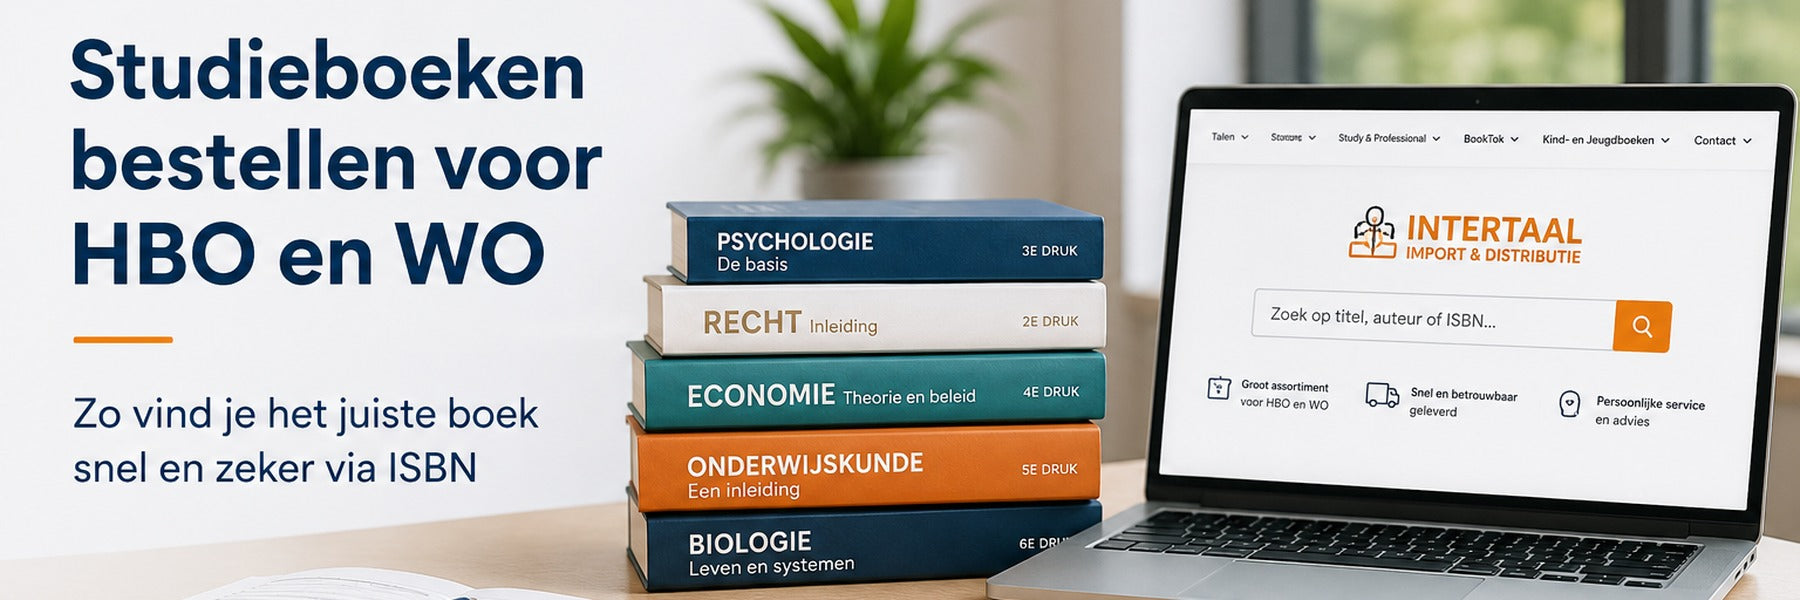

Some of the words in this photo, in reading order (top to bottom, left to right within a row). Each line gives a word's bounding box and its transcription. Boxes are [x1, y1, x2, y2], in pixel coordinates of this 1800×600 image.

[1212, 132, 1235, 141] Talen
[1339, 133, 1364, 144] Study
[1365, 134, 1371, 142] &
[1374, 134, 1426, 143] Professional
[1464, 134, 1504, 143] BookTok
[1543, 135, 1569, 144] Kind-
[1586, 135, 1654, 147] Jeugdboeken
[1694, 136, 1736, 145] Contact
[1408, 215, 1582, 244] INTERTAAL
[718, 232, 873, 250] PSYCHOLOGIE
[1023, 245, 1037, 256] 3E
[1042, 246, 1077, 256] DRUK
[1406, 246, 1466, 260] IMPORT
[1470, 248, 1480, 261] &
[1486, 248, 1581, 264] DISTRIBUTIE
[718, 257, 740, 271] De
[746, 257, 787, 271] basis
[705, 310, 802, 334] RECHT
[811, 319, 877, 336] Inleiding
[1023, 316, 1038, 327] 2E
[1043, 316, 1078, 326] DRUK
[1271, 307, 1307, 321] Zoek
[1312, 312, 1330, 325] op
[1335, 309, 1368, 325] titel,
[1373, 313, 1422, 325] auteur
[1427, 312, 1442, 326] of
[1447, 313, 1495, 328] ISBN...
[1024, 387, 1038, 397] 4E
[1044, 386, 1079, 397] DRUK
[1242, 379, 1267, 391] Groot
[1271, 382, 1328, 392] assortiment
[689, 383, 835, 407] ECONOMIE
[843, 390, 901, 404] Theorie
[907, 394, 924, 403] en
[930, 389, 975, 403] beleid
[1411, 387, 1433, 397] Snel
[1452, 389, 1518, 401] betrouwbaar
[1241, 399, 1263, 407] voor
[1267, 398, 1290, 408] HBO
[1309, 400, 1329, 410] WO
[1597, 396, 1662, 410] Persoonlijke
[1666, 400, 1705, 410] service
[1410, 406, 1457, 417] geleverd
[1613, 416, 1649, 427] advies
[688, 452, 923, 477] ONDERWIJSKUNDE
[1022, 464, 1037, 475] 5E
[1042, 464, 1077, 474] DRUK
[689, 483, 720, 498] Een
[727, 482, 799, 500] inleiding
[690, 531, 811, 554] BIOLOGIE
[1020, 538, 1034, 549] 6E
[690, 561, 741, 576] Leven
[747, 563, 767, 574] en
[774, 559, 854, 576] systemen
